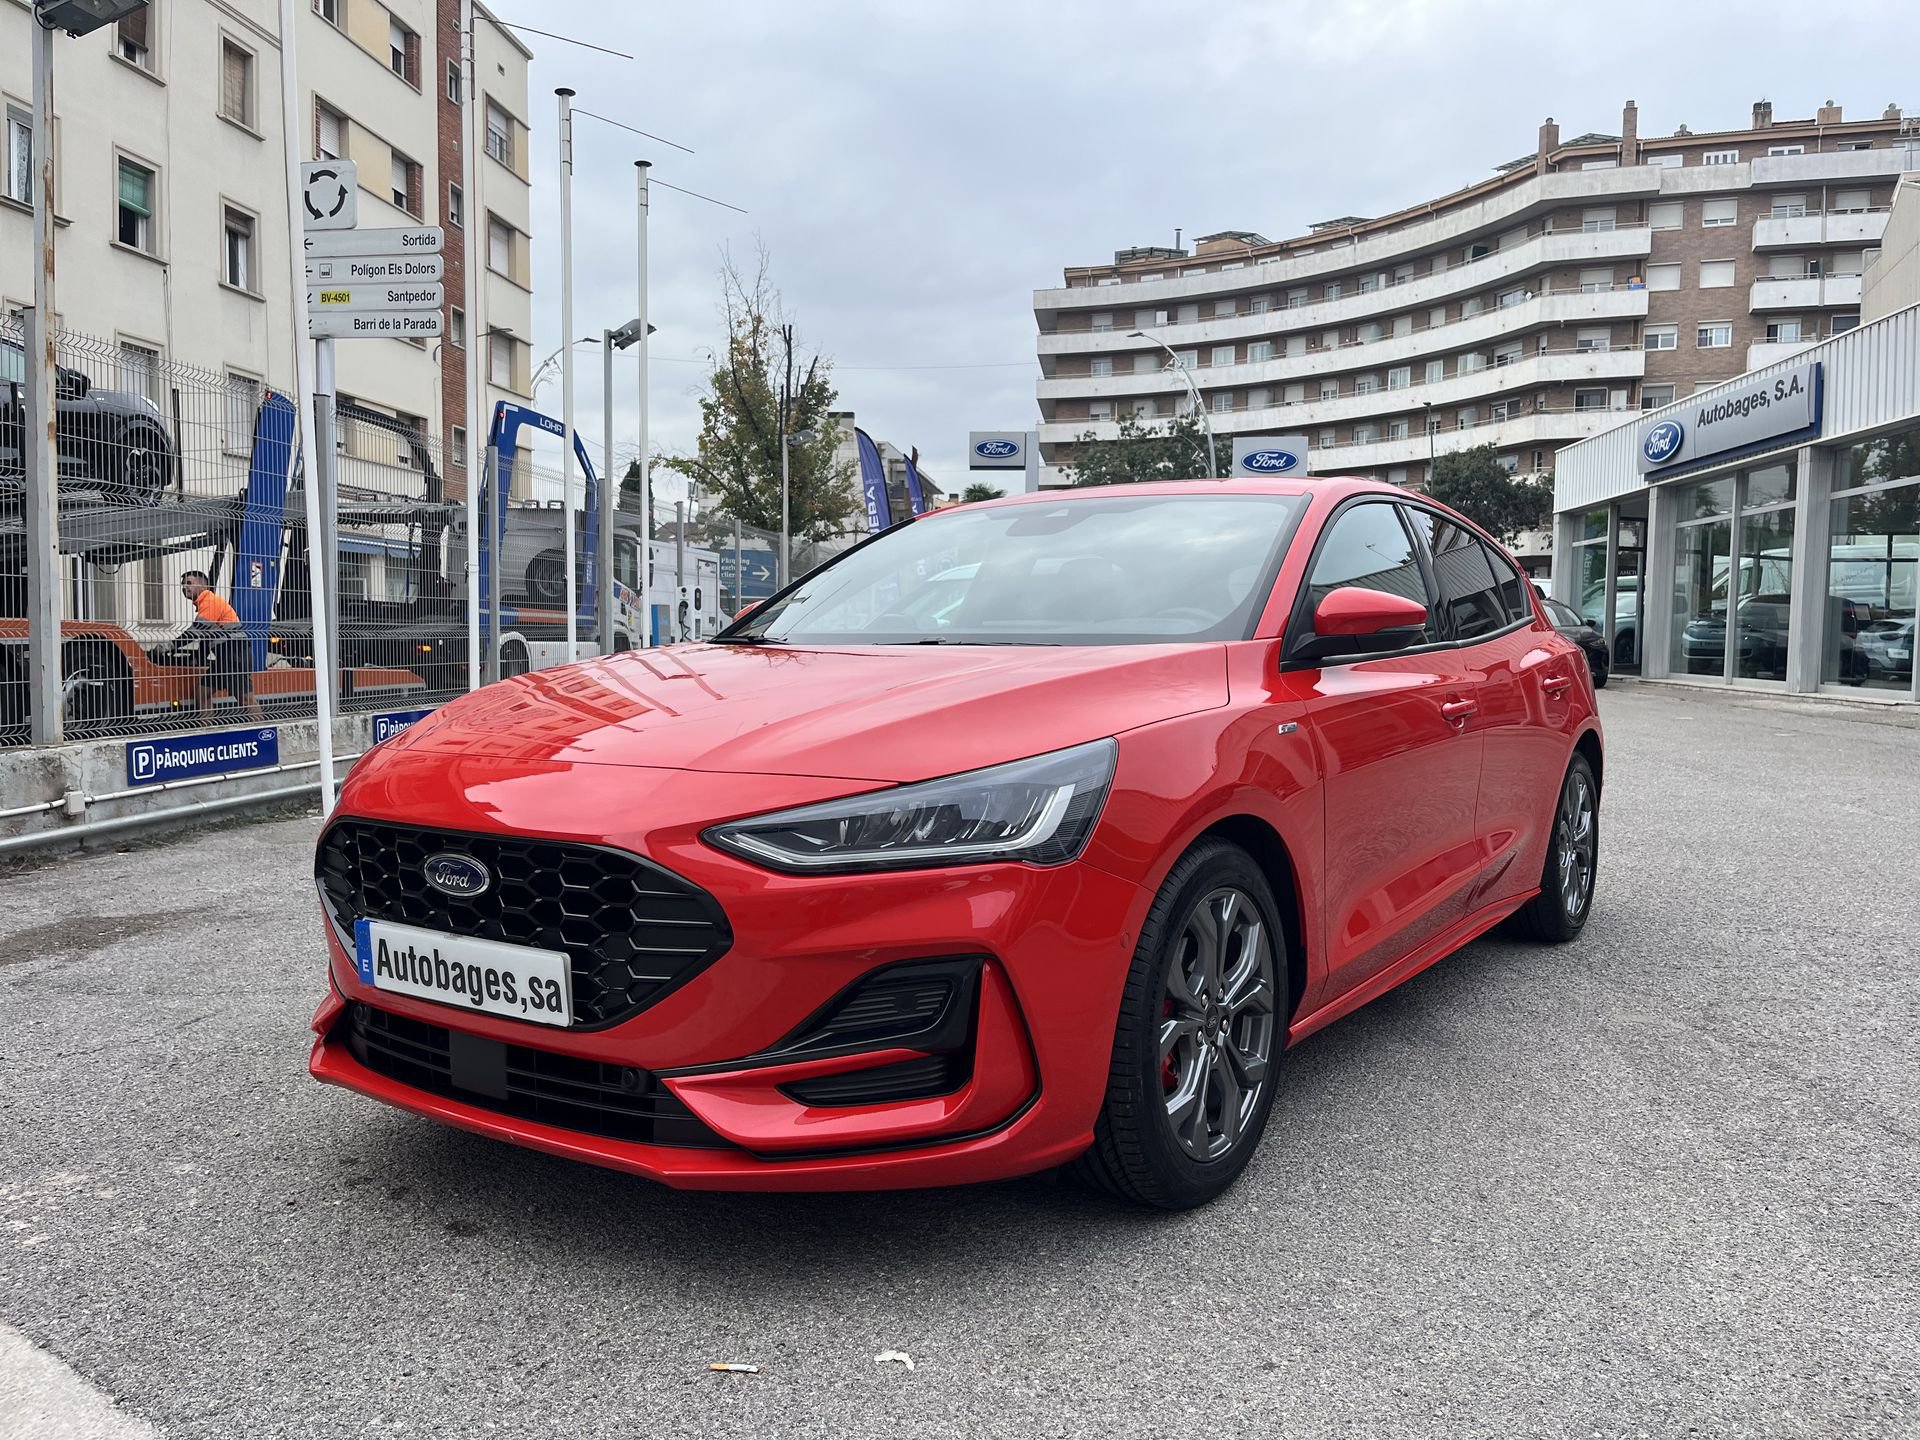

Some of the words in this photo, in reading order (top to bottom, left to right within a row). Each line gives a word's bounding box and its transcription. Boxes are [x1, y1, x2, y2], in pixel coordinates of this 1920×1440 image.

[402, 233, 437, 247] Sortida
[351, 263, 386, 279] Polígon
[388, 263, 403, 275] Els
[405, 262, 436, 275] Dolors
[321, 292, 351, 303] BV-4501
[387, 289, 436, 304] Santpedor
[353, 318, 377, 330] Barri
[378, 318, 391, 330] de
[392, 318, 401, 330] la
[403, 317, 437, 330] Parada
[1697, 389, 1771, 428] Autobages,
[1774, 374, 1804, 401] S.A.
[540, 417, 563, 434] LOHR
[983, 442, 1011, 454] Ford
[1648, 427, 1673, 456] Ford
[1252, 452, 1288, 468] Ford
[156, 747, 215, 769] PÀRQUING
[217, 741, 258, 761] CLIENTS
[435, 862, 471, 889] Ford
[362, 959, 370, 972] E
[376, 938, 564, 1014] Autobages,sa
